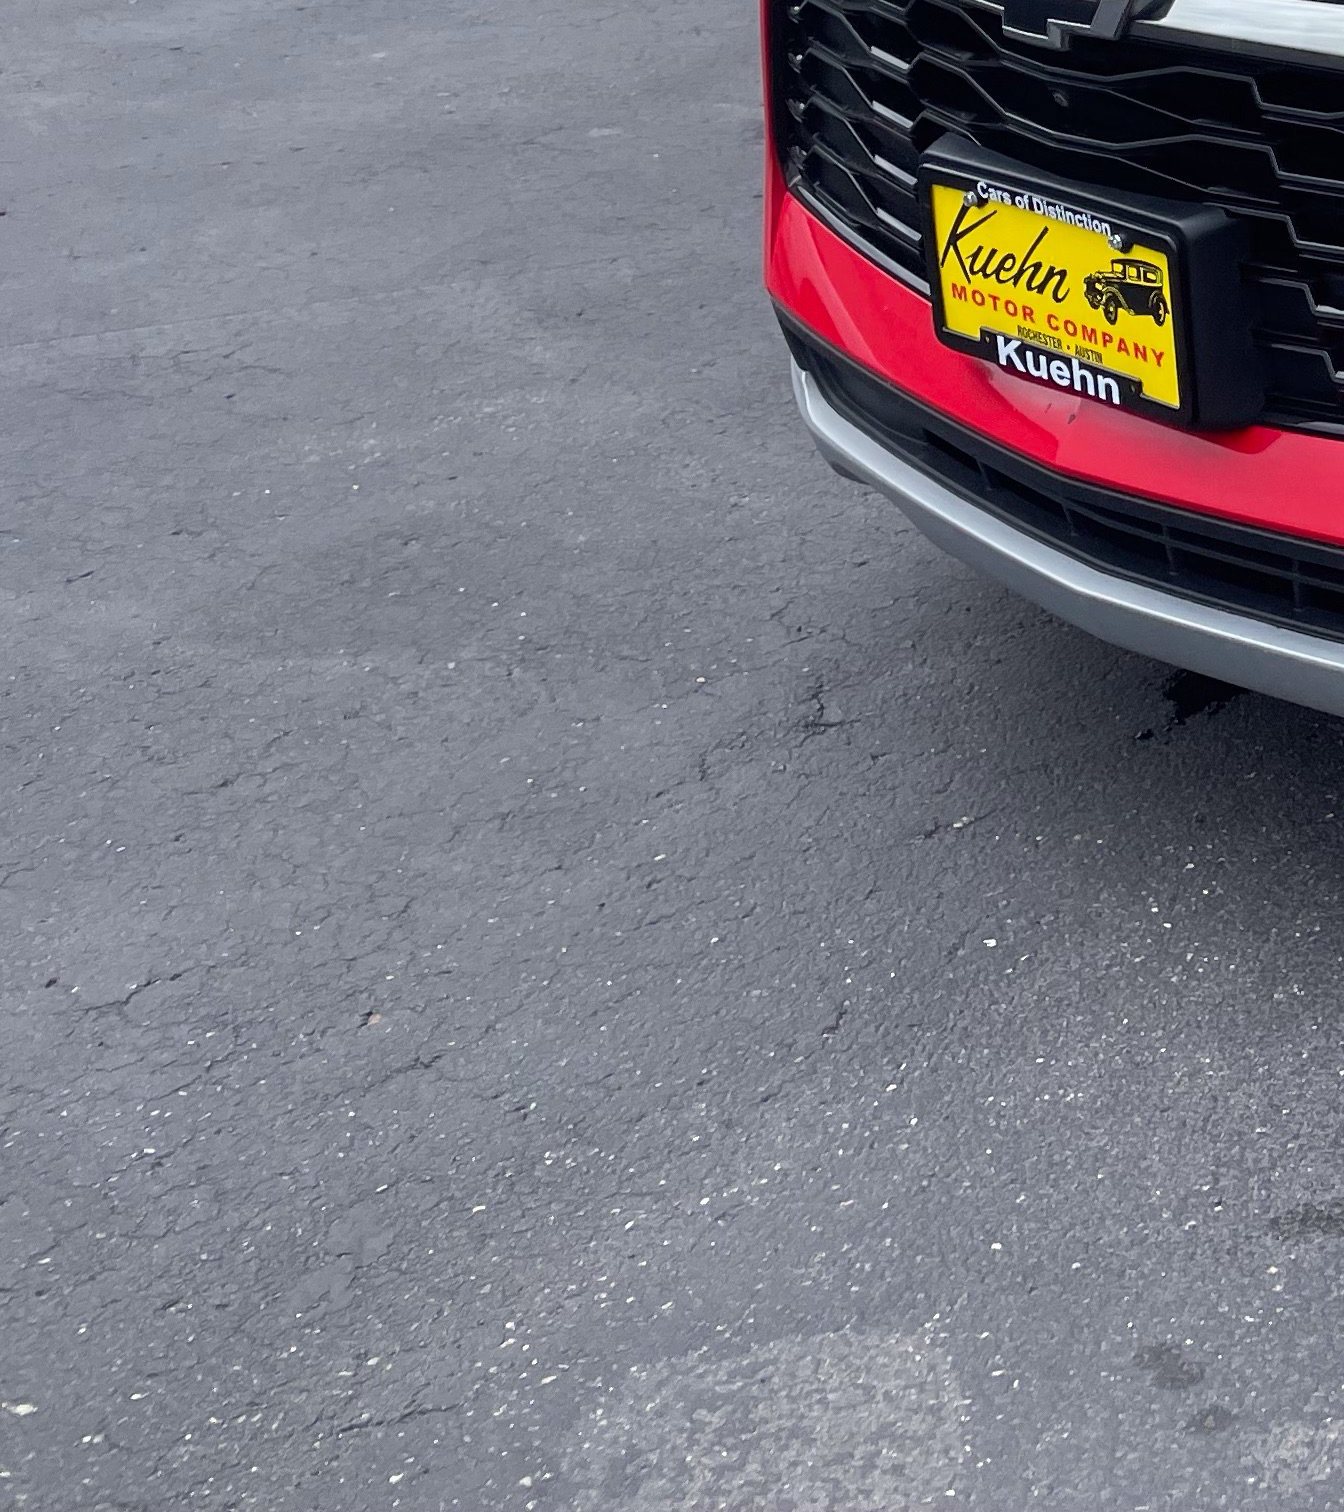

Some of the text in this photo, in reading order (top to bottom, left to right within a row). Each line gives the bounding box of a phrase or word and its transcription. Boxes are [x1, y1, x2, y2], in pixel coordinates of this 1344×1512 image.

[976, 181, 1113, 237] Cars of Distinction
[940, 202, 1070, 304] Kuehn
[951, 282, 1165, 368] MOTOR COMPANY
[1017, 325, 1104, 365] ROCHESTER AUSTIN
[996, 335, 1121, 405] Kuehn
